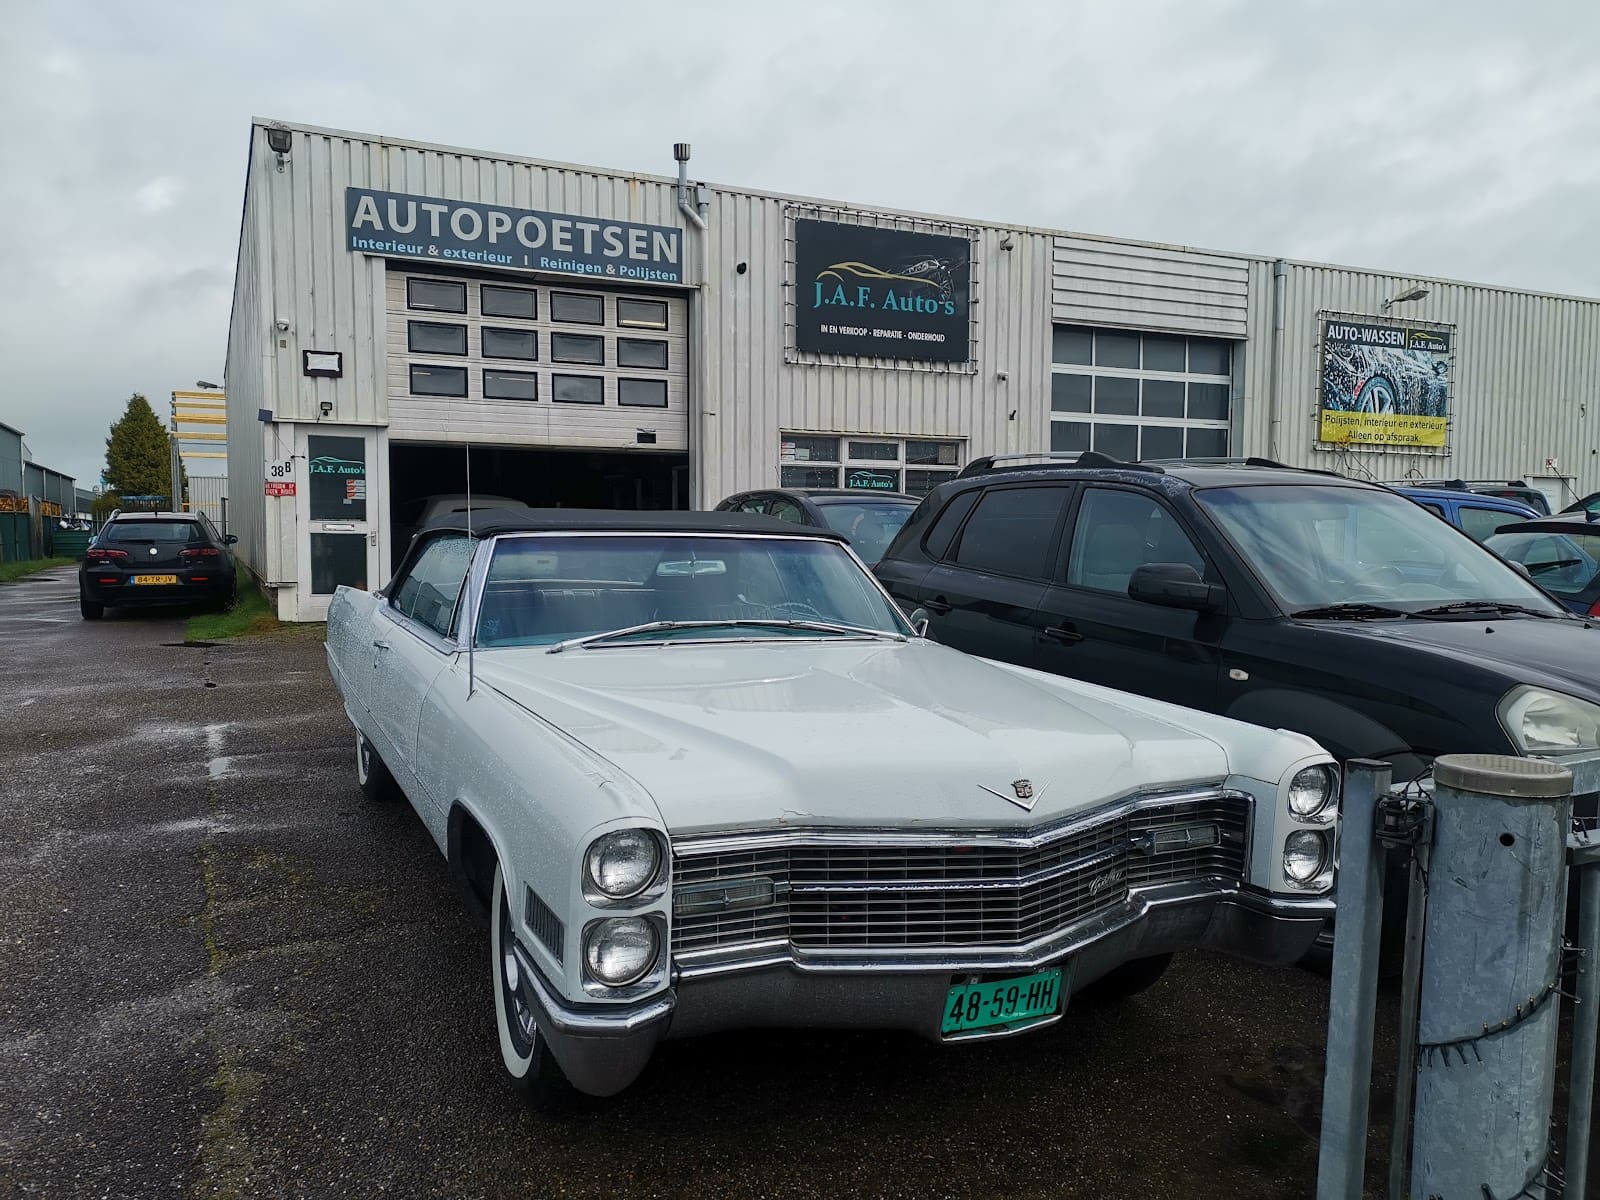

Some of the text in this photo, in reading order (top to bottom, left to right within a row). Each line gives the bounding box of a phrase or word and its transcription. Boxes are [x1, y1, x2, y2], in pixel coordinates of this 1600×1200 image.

[351, 195, 678, 264] AUTOPOETSEN
[352, 236, 423, 254] Interieur
[427, 244, 439, 256] &
[443, 248, 512, 264] exterieur
[540, 256, 602, 274] Reinigen
[605, 263, 616, 275] &
[619, 265, 678, 281] Polijsten
[813, 282, 955, 316] J.A.F. Auto's
[820, 324, 828, 333] IN
[829, 325, 838, 334] EN
[838, 326, 868, 336] VERKOOP
[872, 328, 903, 339] REPARATIE
[907, 331, 945, 343] ONDERHOUD
[1327, 324, 1405, 346] AUTO-WASSEN
[1325, 414, 1444, 430] Polijsten, interieur en exterieur
[1348, 430, 1420, 443] Alleen op afspraak
[309, 464, 336, 474] J.A.F.
[136, 575, 174, 584] 84-TR-JV
[949, 978, 1055, 1025] 48-59-HH
